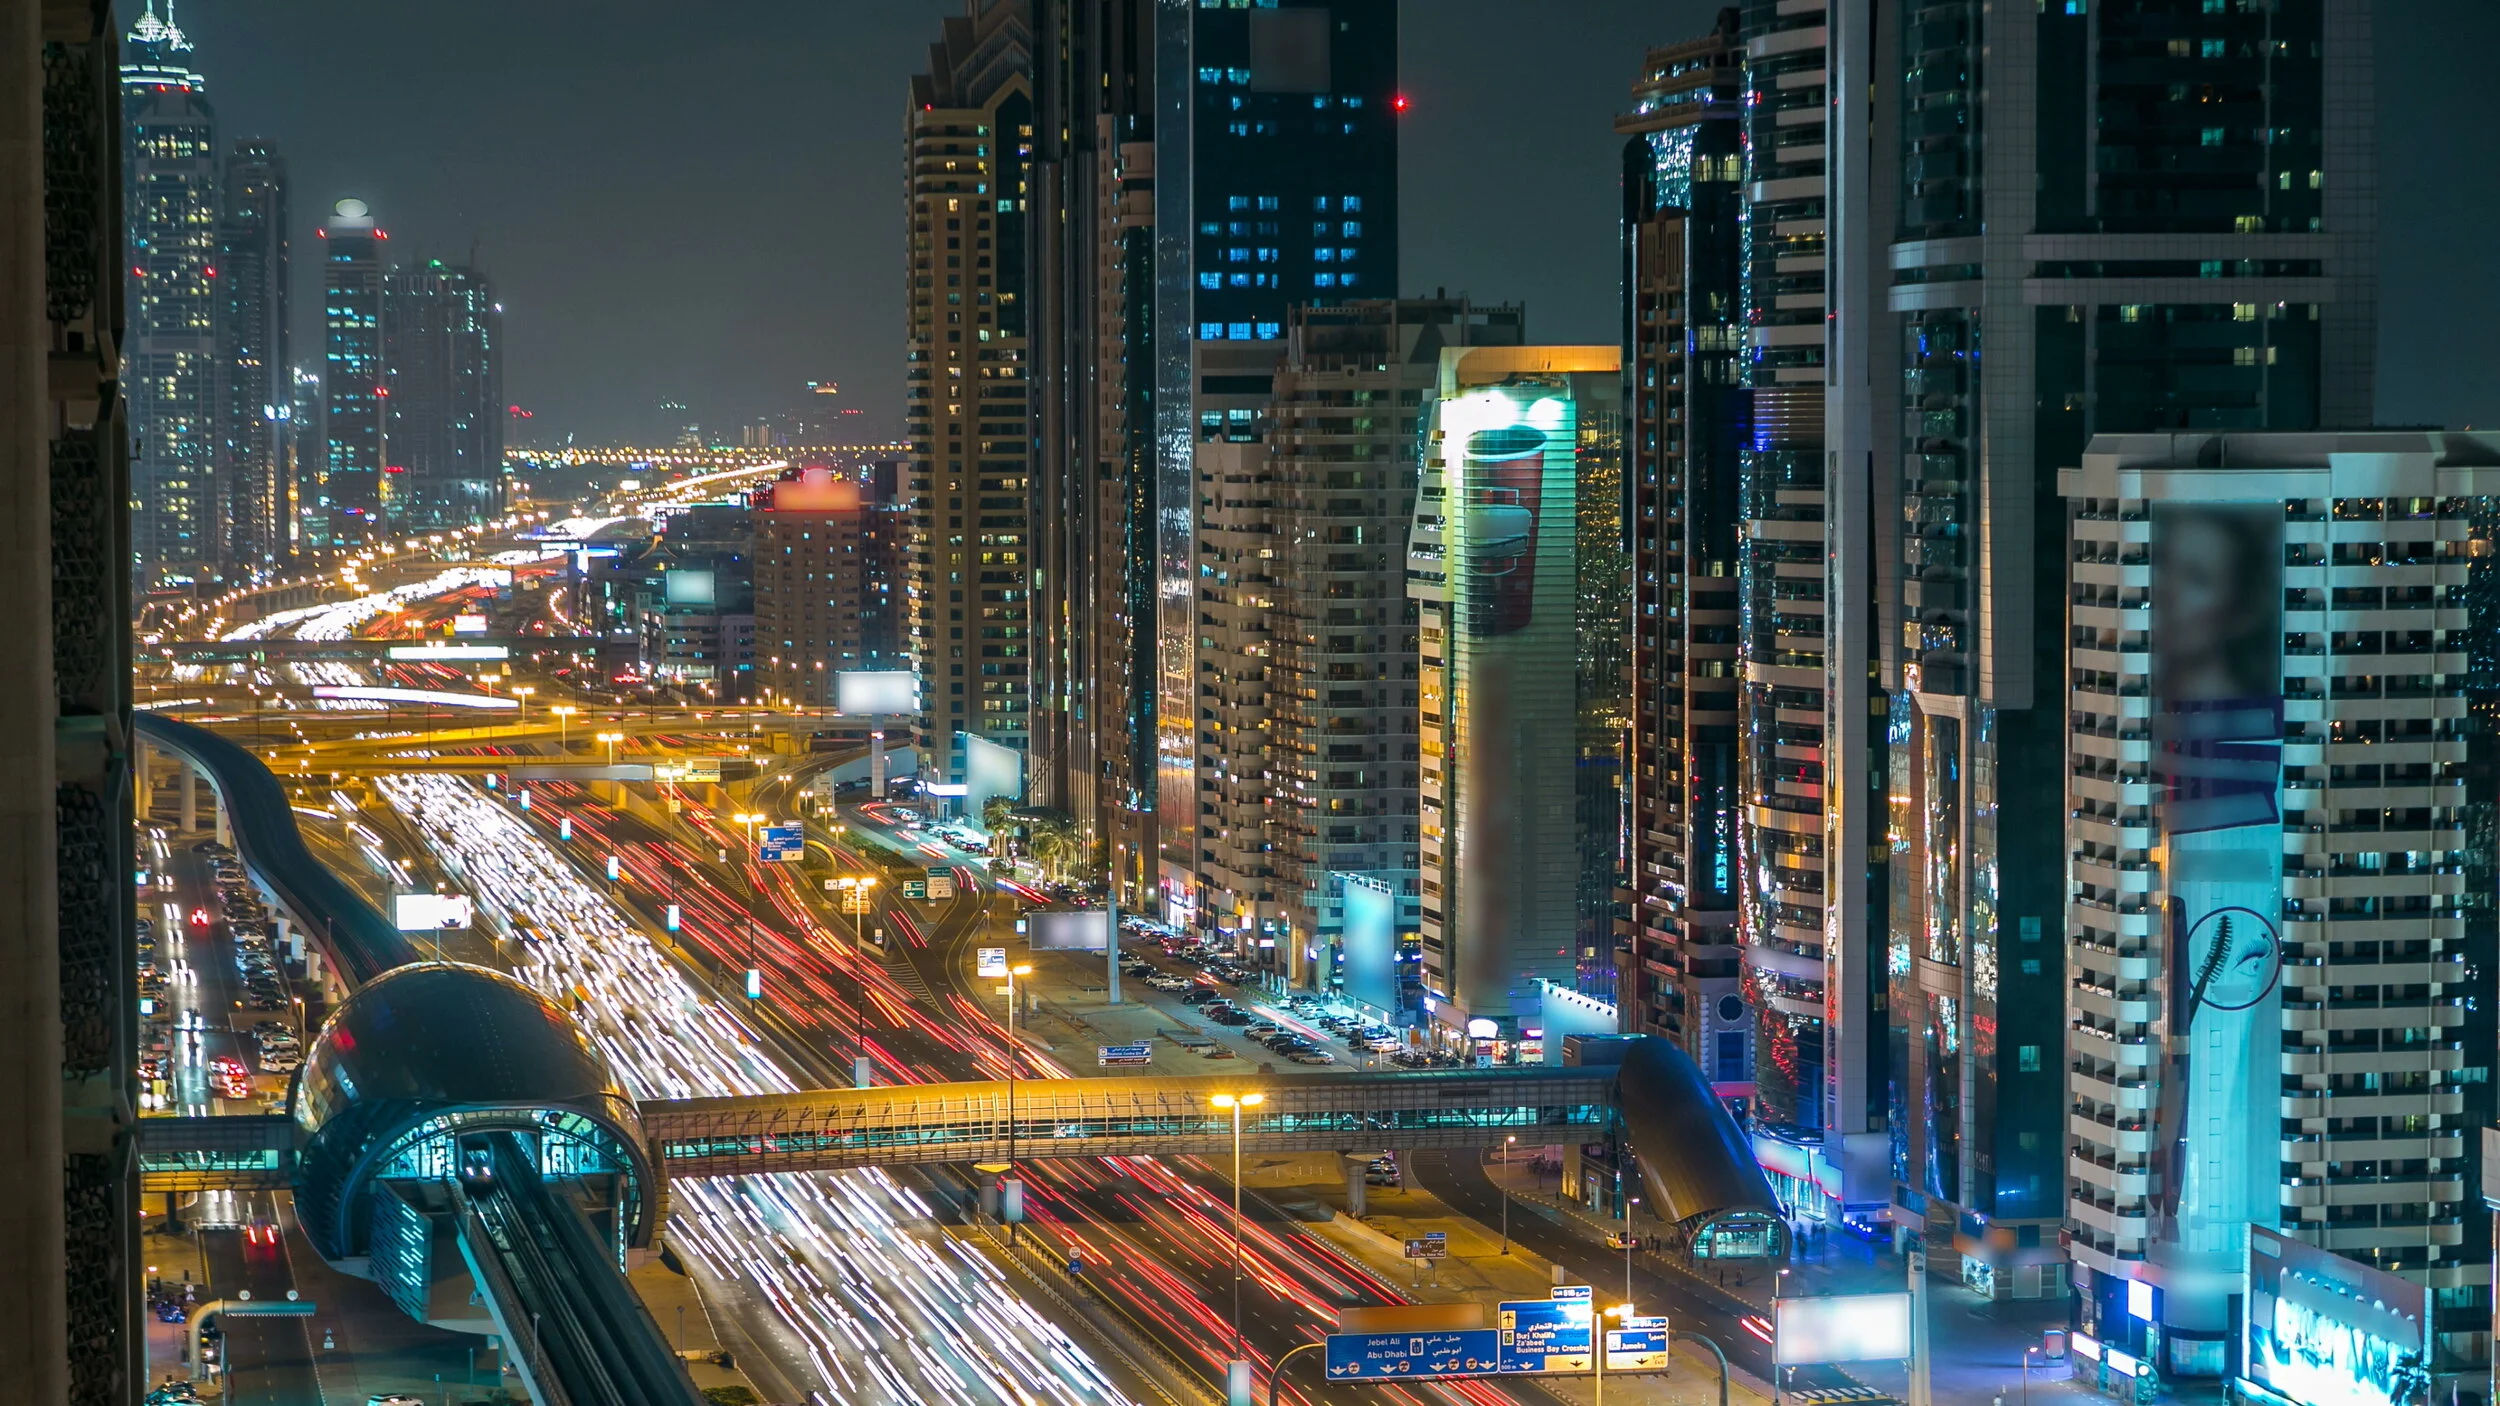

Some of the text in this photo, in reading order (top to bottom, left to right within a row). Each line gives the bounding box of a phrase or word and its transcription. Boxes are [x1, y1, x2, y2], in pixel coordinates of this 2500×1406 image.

[1426, 1335, 1461, 1346] جبل علي
[1516, 1332, 1529, 1340] Burj
[1367, 1337, 1400, 1347] Jebel Ali
[1562, 1344, 1590, 1353] Crossing
[1367, 1350, 1407, 1359] Abu Dhabi
